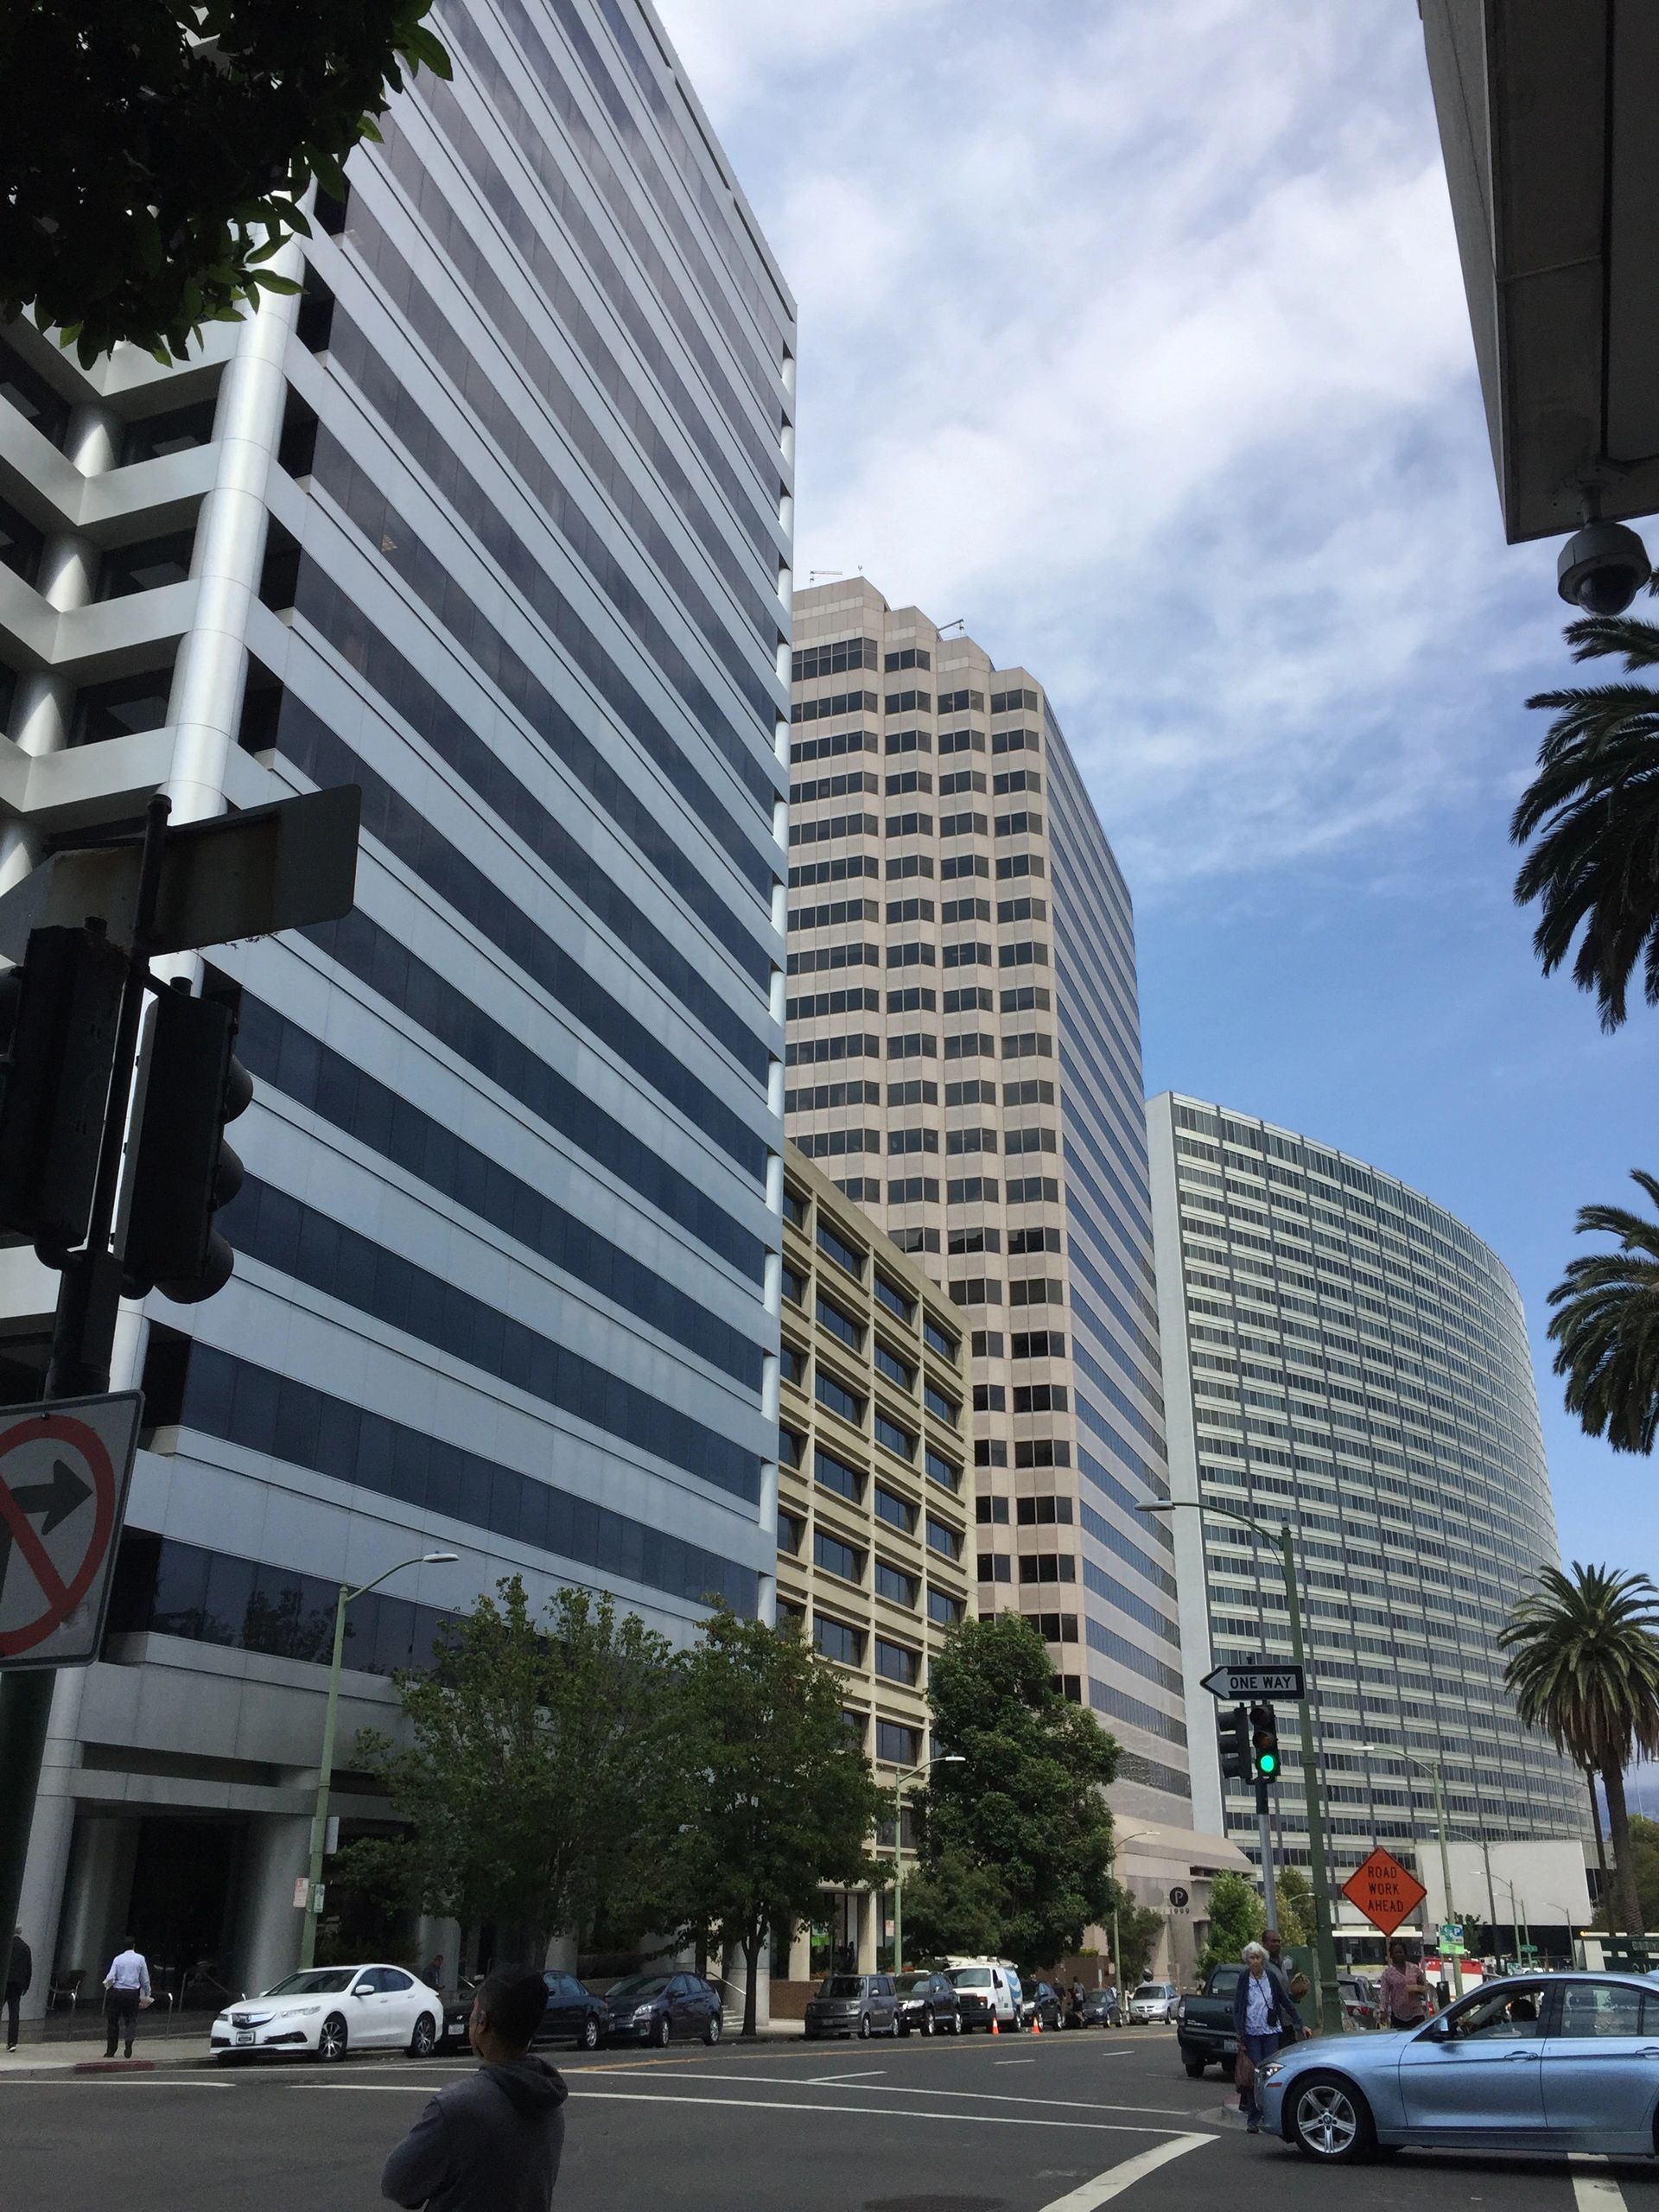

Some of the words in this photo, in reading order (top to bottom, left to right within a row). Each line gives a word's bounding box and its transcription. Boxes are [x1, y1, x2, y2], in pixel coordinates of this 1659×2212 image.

[1230, 1676, 1257, 1689] ONE
[1262, 1676, 1292, 1689] WAY
[1367, 1866, 1397, 1879] ROAD
[1368, 1882, 1400, 1895] WORK
[1174, 1890, 1184, 1904] P
[1367, 1899, 1404, 1912] AHEAD
